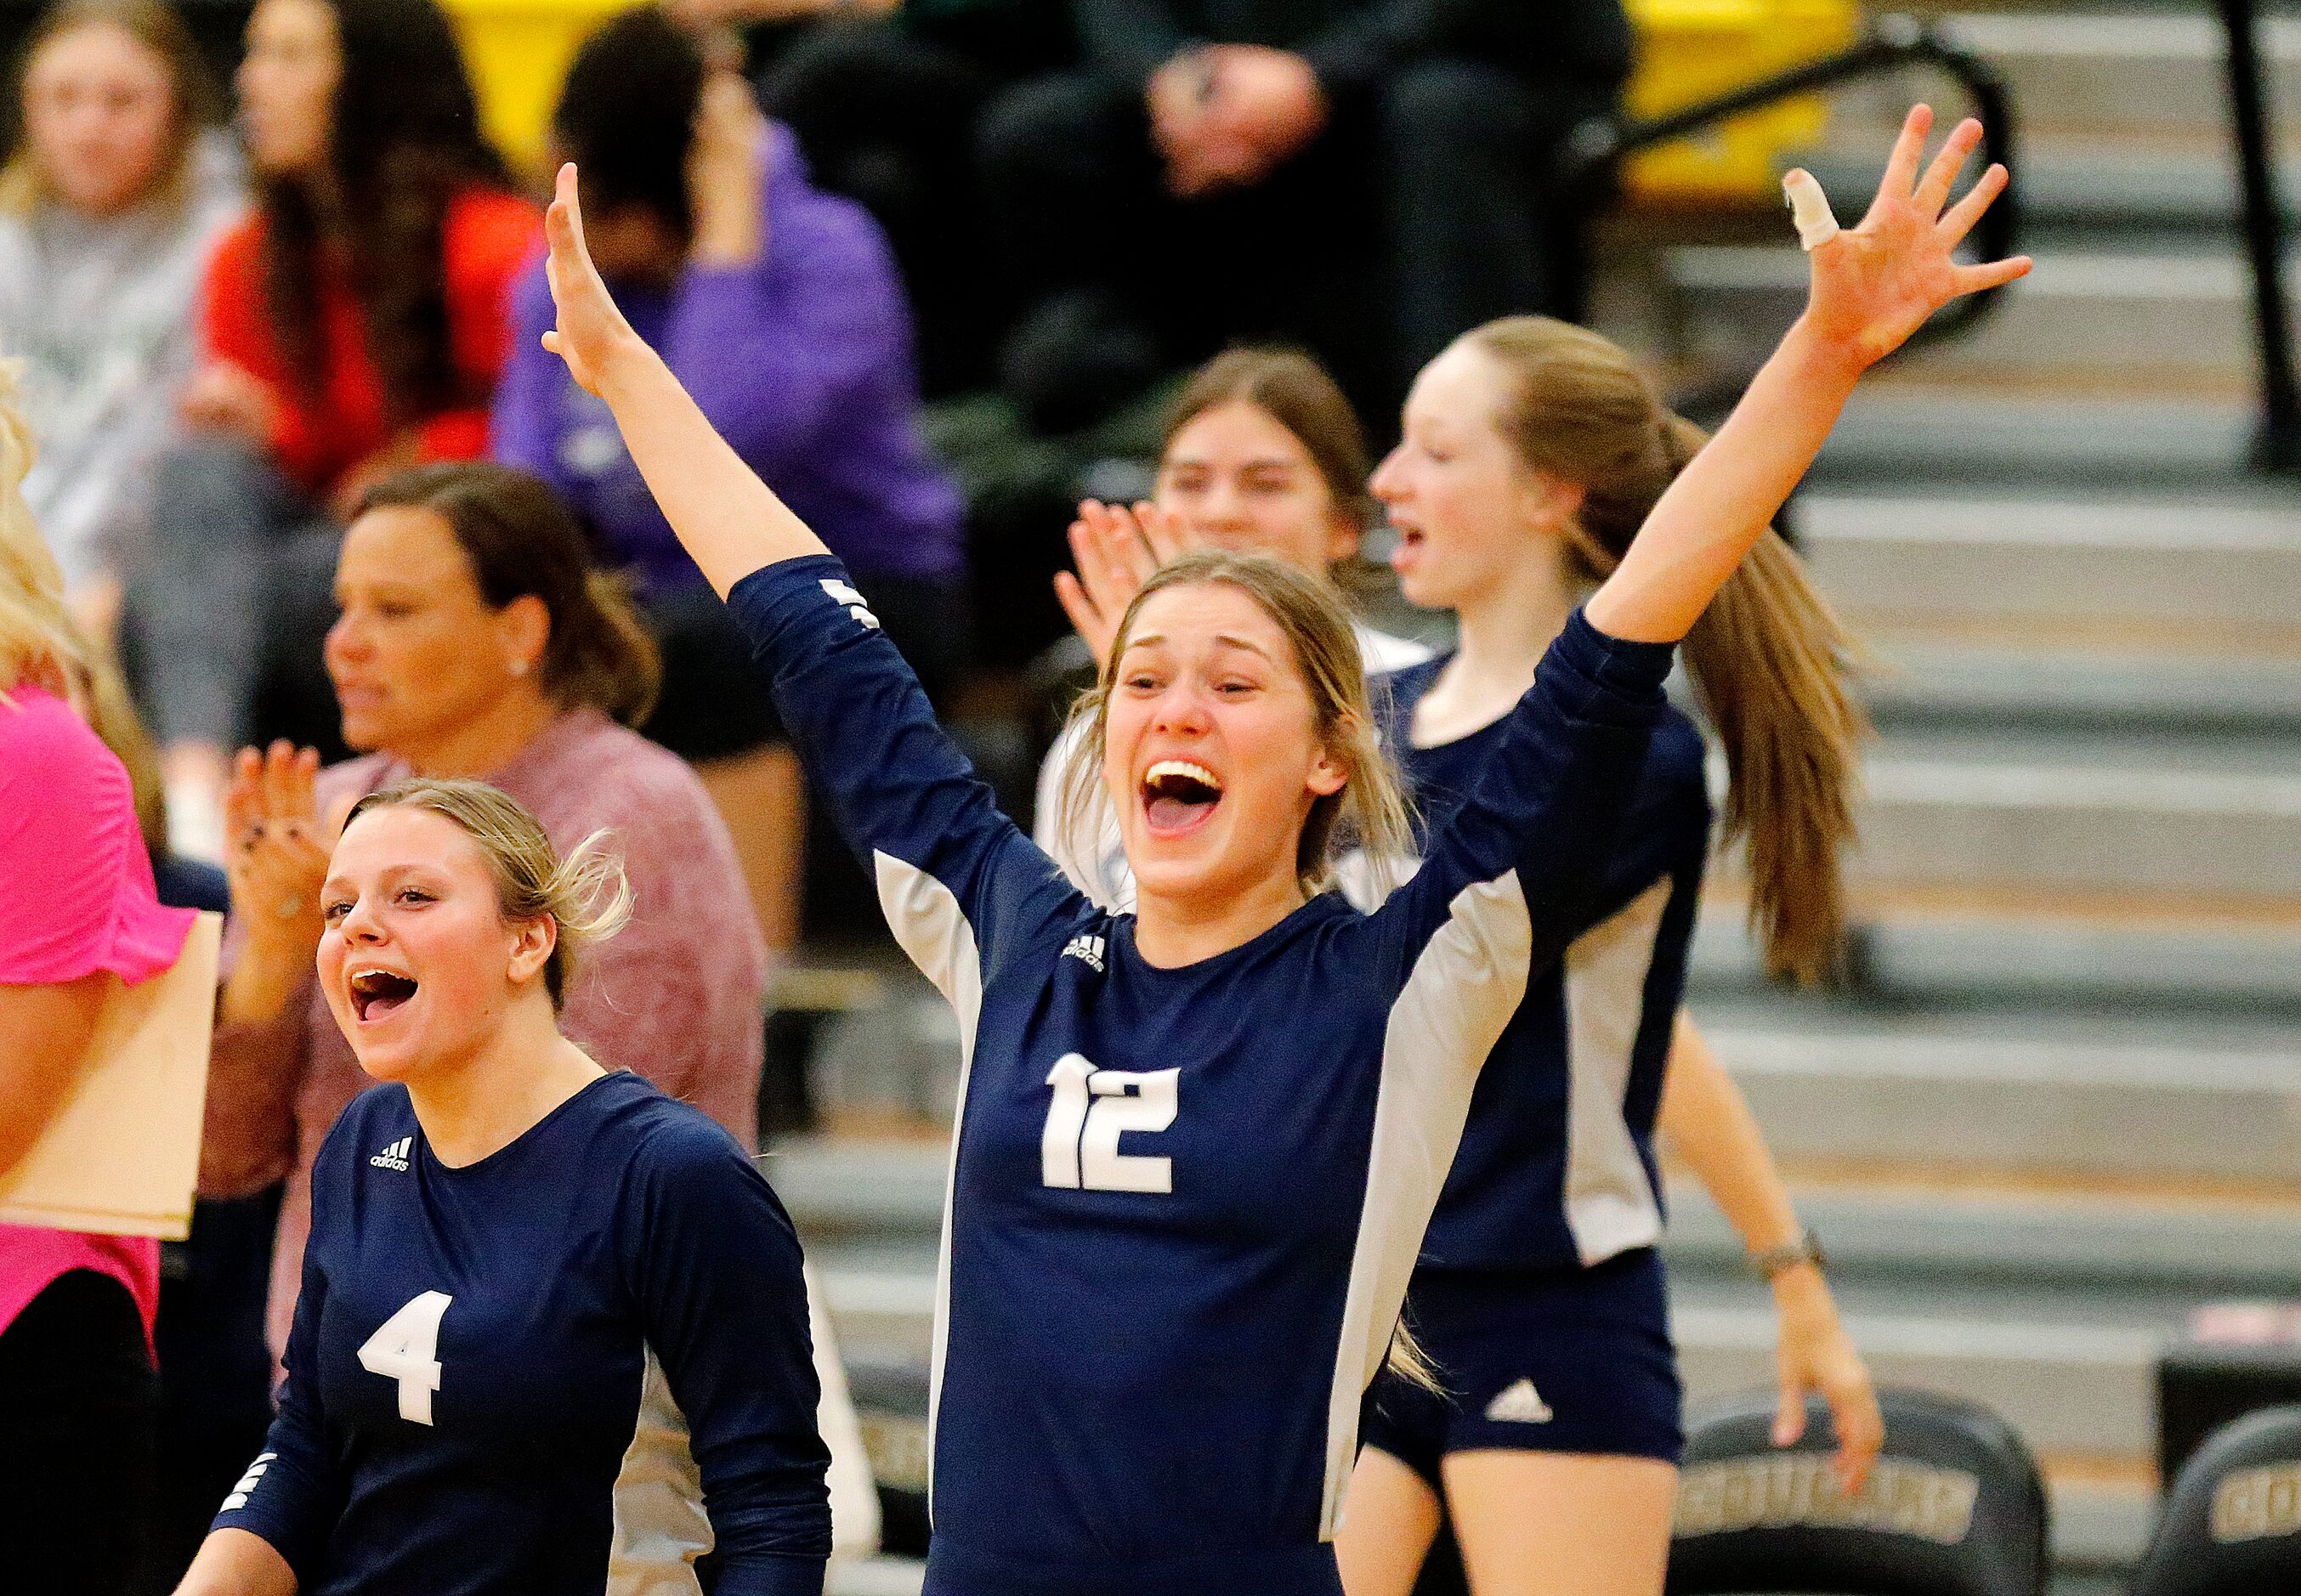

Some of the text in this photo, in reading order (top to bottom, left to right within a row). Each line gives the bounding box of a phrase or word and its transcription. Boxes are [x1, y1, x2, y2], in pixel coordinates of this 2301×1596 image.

[370, 1153, 410, 1172] adidas
[1041, 1052, 1182, 1194] 12
[356, 1289, 453, 1427] 4
